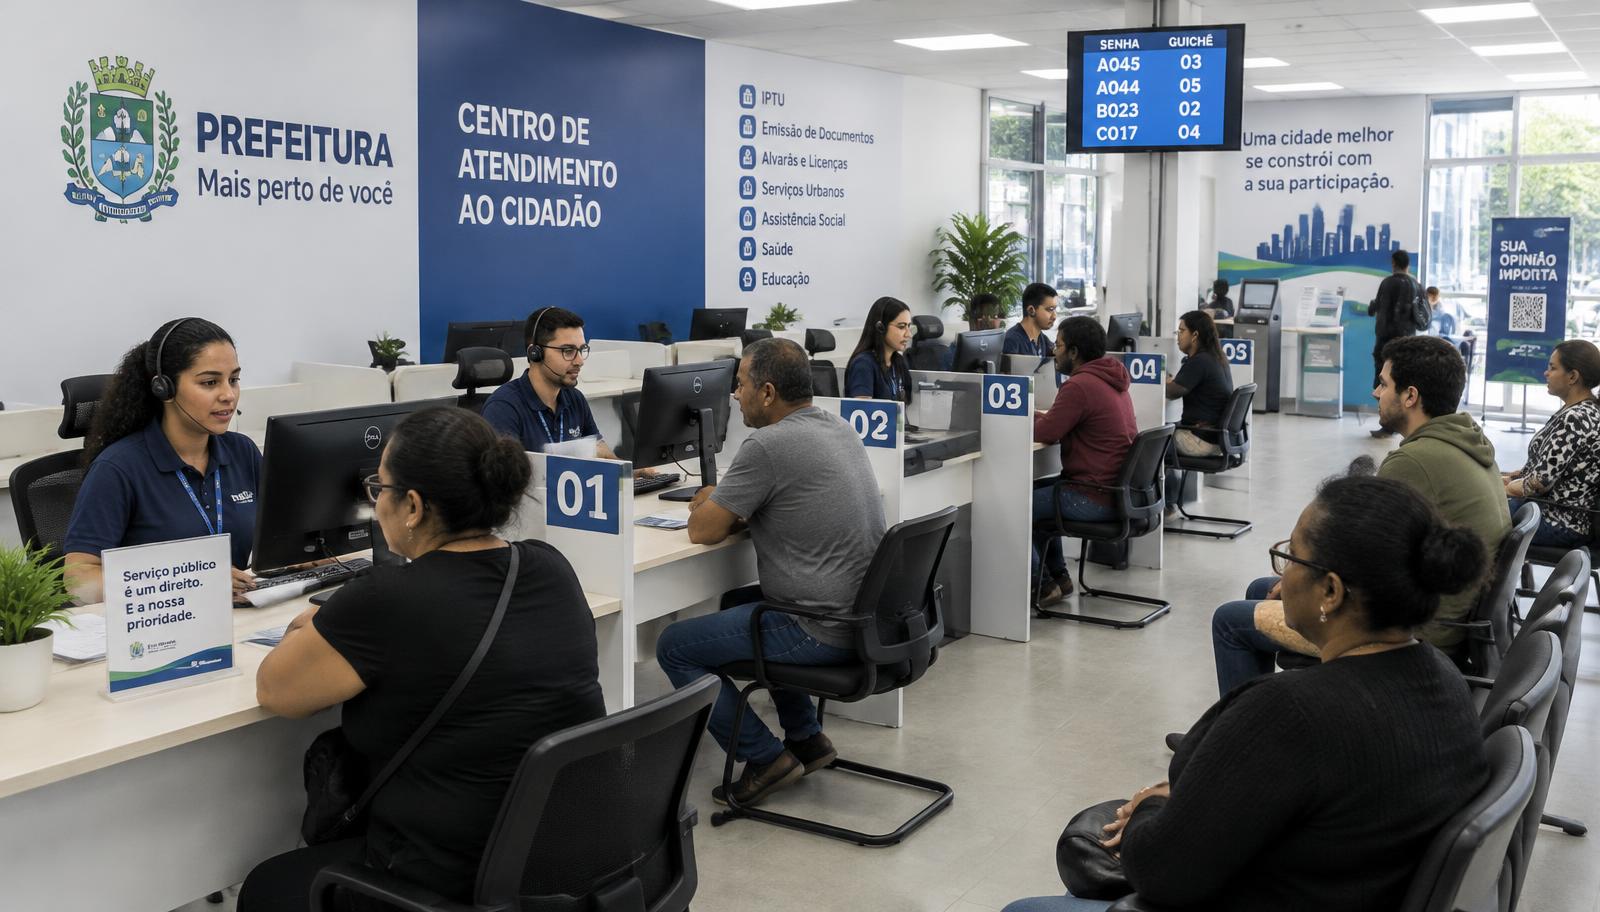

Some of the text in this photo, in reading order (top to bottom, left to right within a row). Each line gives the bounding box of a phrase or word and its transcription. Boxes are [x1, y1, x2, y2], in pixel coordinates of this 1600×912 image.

[1101, 34, 1213, 50] SENHA GUICHÊ
[1097, 54, 1201, 72] A045 03
[1096, 78, 1201, 95] A044 05
[762, 91, 784, 106] IPTU
[1097, 101, 1200, 118] B023 02
[459, 103, 589, 145] CENTRO DE
[763, 121, 874, 144] Emissão de Documentos
[1097, 125, 1200, 140] C017 04
[197, 112, 393, 167] PREFEITURA
[1243, 127, 1394, 146] Uma cidade melhor
[458, 149, 617, 188] ATENDIMENTO
[801, 157, 806, 167] e
[809, 155, 847, 172] Licenças
[1246, 151, 1371, 168] se constrói com
[199, 168, 392, 205] Mais perto de você
[762, 181, 844, 200] Serviços Urbanos
[1245, 180, 1253, 191] a
[1258, 179, 1284, 191] sua
[459, 194, 601, 227] AO CIDADÃO
[762, 212, 846, 226] Assistência Social
[762, 242, 793, 255] Saúde
[1500, 240, 1528, 252] SUA
[1129, 358, 1157, 380] 04
[988, 382, 1022, 410] 03
[849, 409, 889, 441] 02
[557, 471, 607, 520] 01
[123, 560, 217, 582] Serviço público
[125, 578, 203, 597] é um direito.
[138, 604, 144, 612] a
[149, 597, 185, 610] nossa
[127, 610, 196, 632] prioridade.
